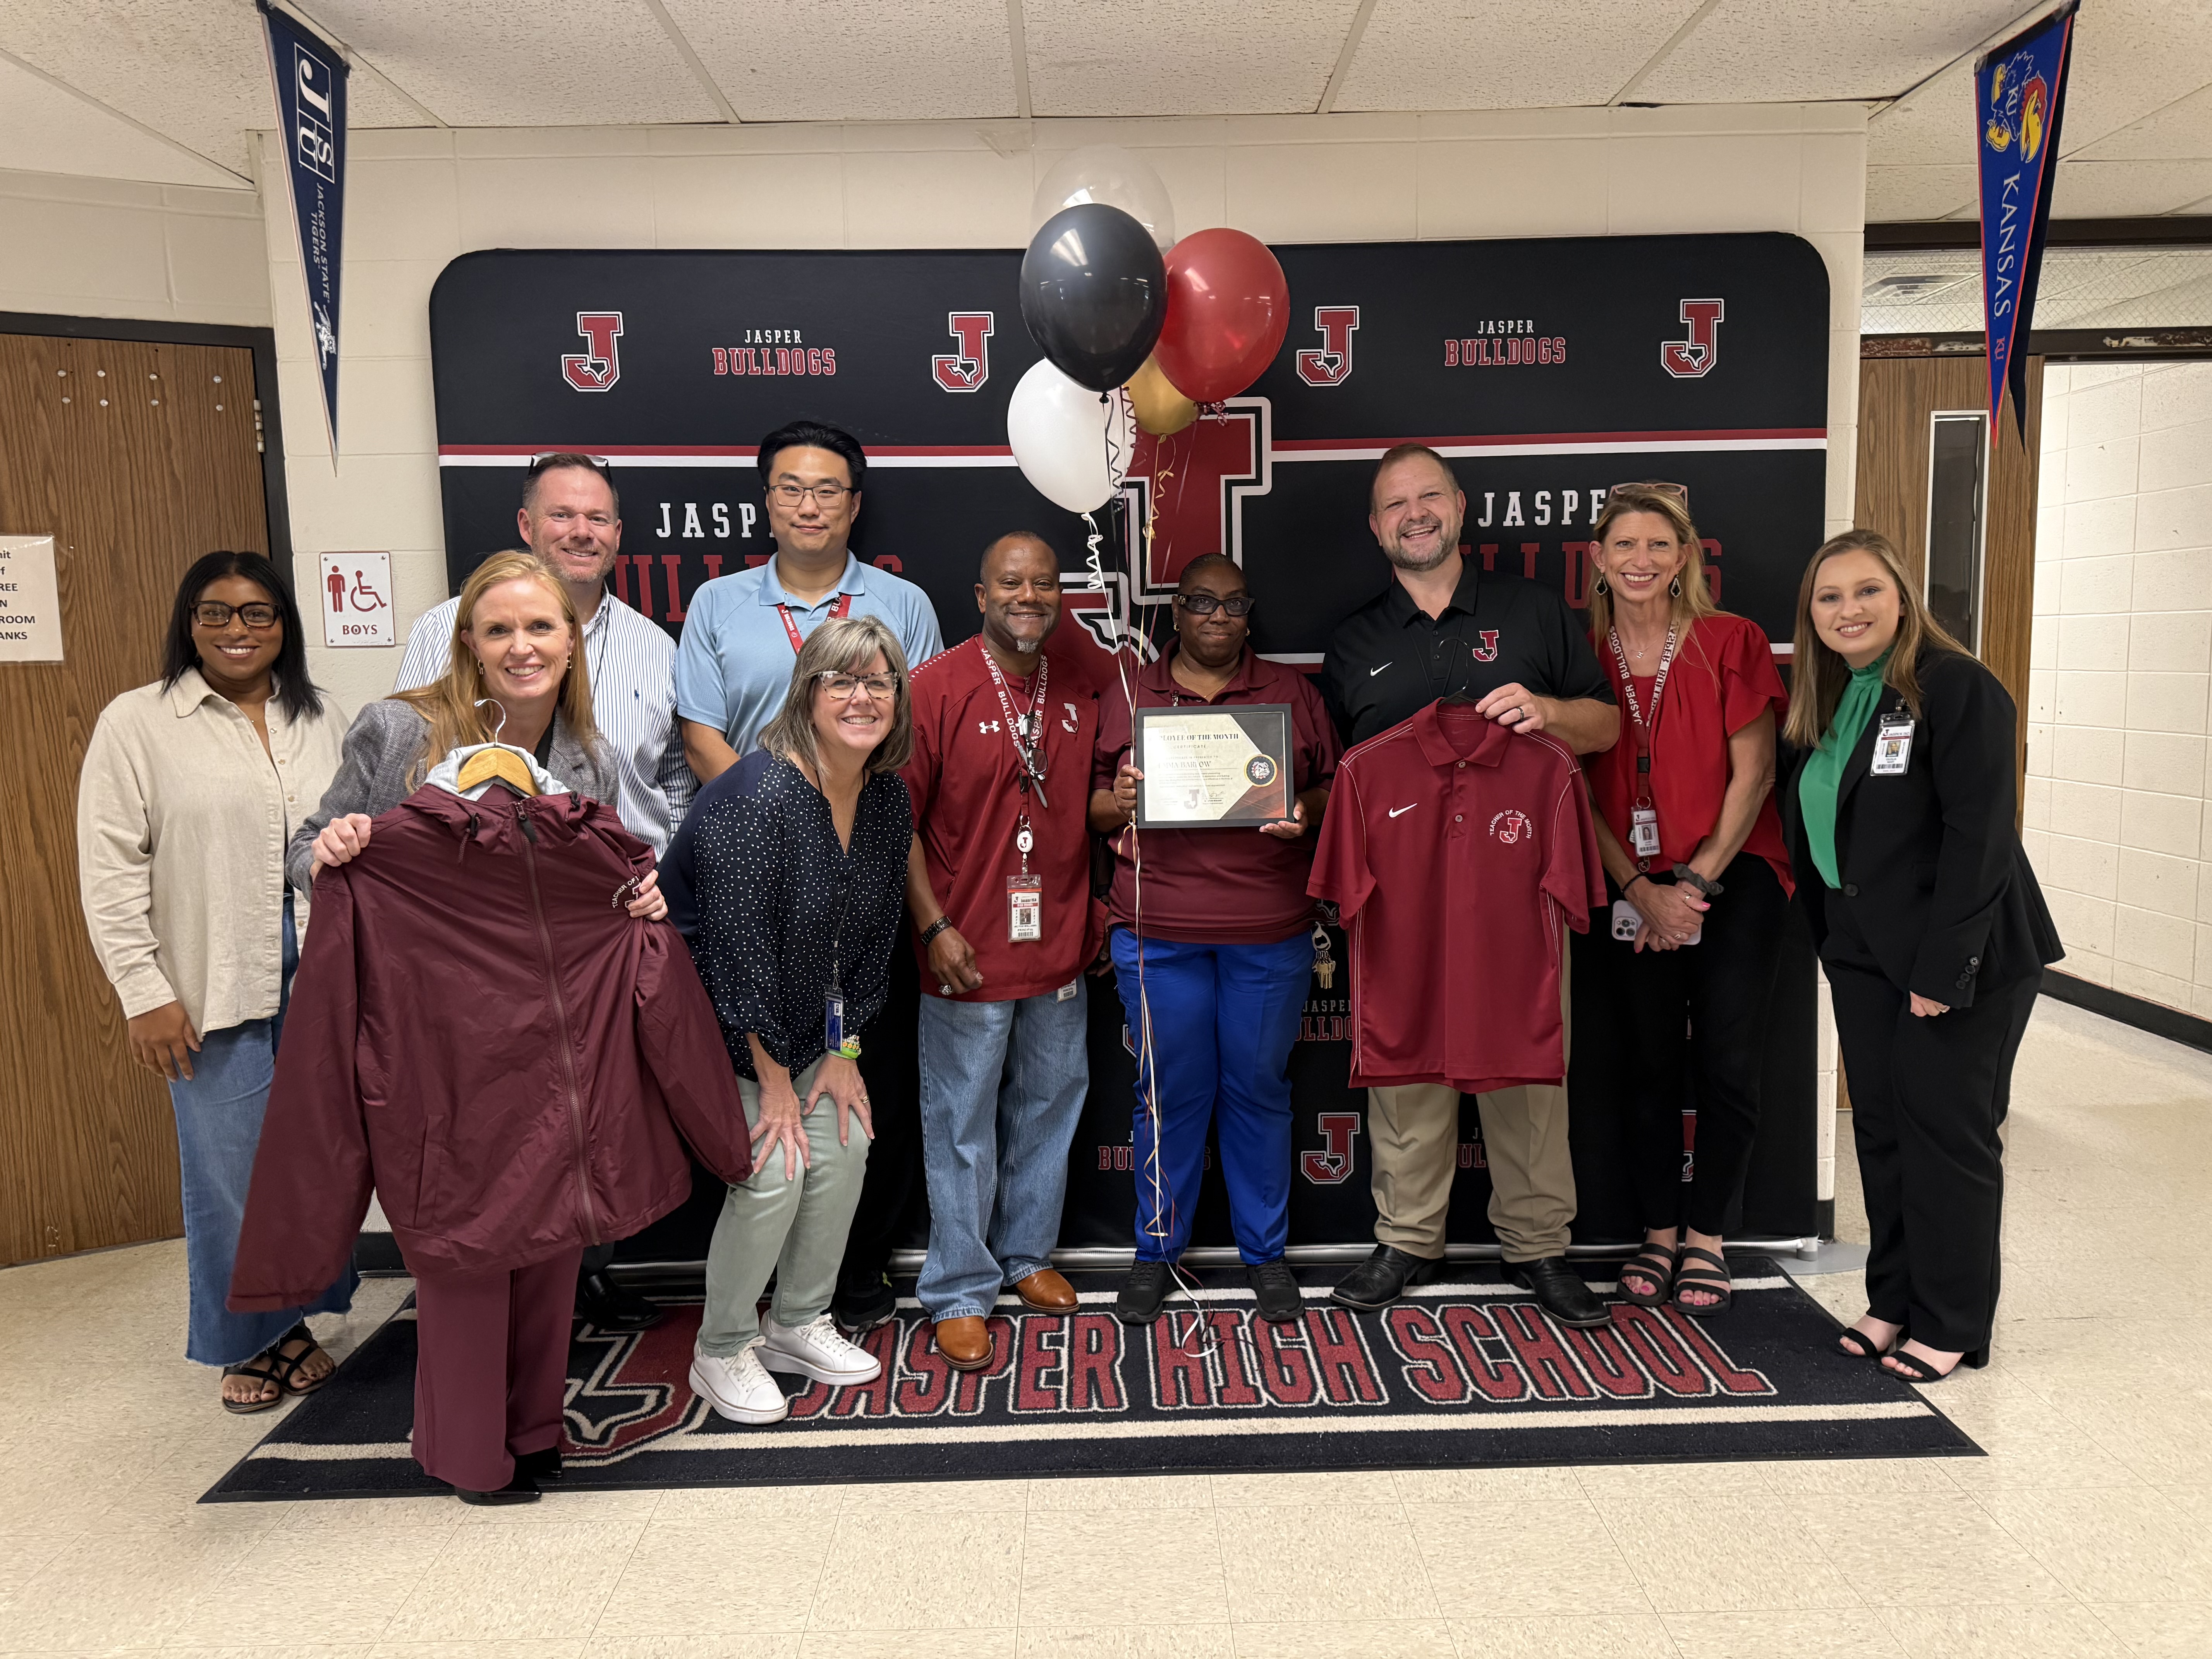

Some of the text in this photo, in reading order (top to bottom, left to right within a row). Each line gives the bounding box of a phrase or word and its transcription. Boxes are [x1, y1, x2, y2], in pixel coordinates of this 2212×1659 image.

[2006, 84, 2018, 116] KU
[311, 212, 320, 267] TIGERS
[317, 182, 330, 301] JACKSON STATE
[1994, 170, 2021, 318] KANSAS
[744, 330, 802, 343] JASPER
[1297, 305, 1359, 386] J
[1477, 320, 1534, 334] JASPER
[1661, 298, 1724, 378] J
[561, 311, 623, 392] J
[712, 348, 836, 375] BULLDOGS
[932, 311, 994, 392] J
[1445, 337, 1566, 366] BULLDOGS
[1994, 336, 2005, 360] KU
[656, 503, 775, 538] JASP
[1478, 489, 1606, 527] JASPE
[342, 625, 378, 635] BOYS
[784, 613, 795, 631] BULLDOGS
[1472, 630, 1499, 662] J
[1609, 626, 1630, 679] BULLDOGS
[981, 647, 1020, 747] JASPER BULLDOGS
[1037, 654, 1049, 704] BULLDOGS
[1625, 684, 1643, 725] JASPER
[1489, 812, 1504, 836] TEACHER
[1515, 810, 1527, 819] THE
[1524, 818, 1532, 839] MONTH
[612, 878, 635, 908] TEACHER OF
[1301, 1112, 1360, 1184] J
[1146, 1307, 1390, 1412] HIGH
[1381, 1300, 1778, 1406] SCHOOL
